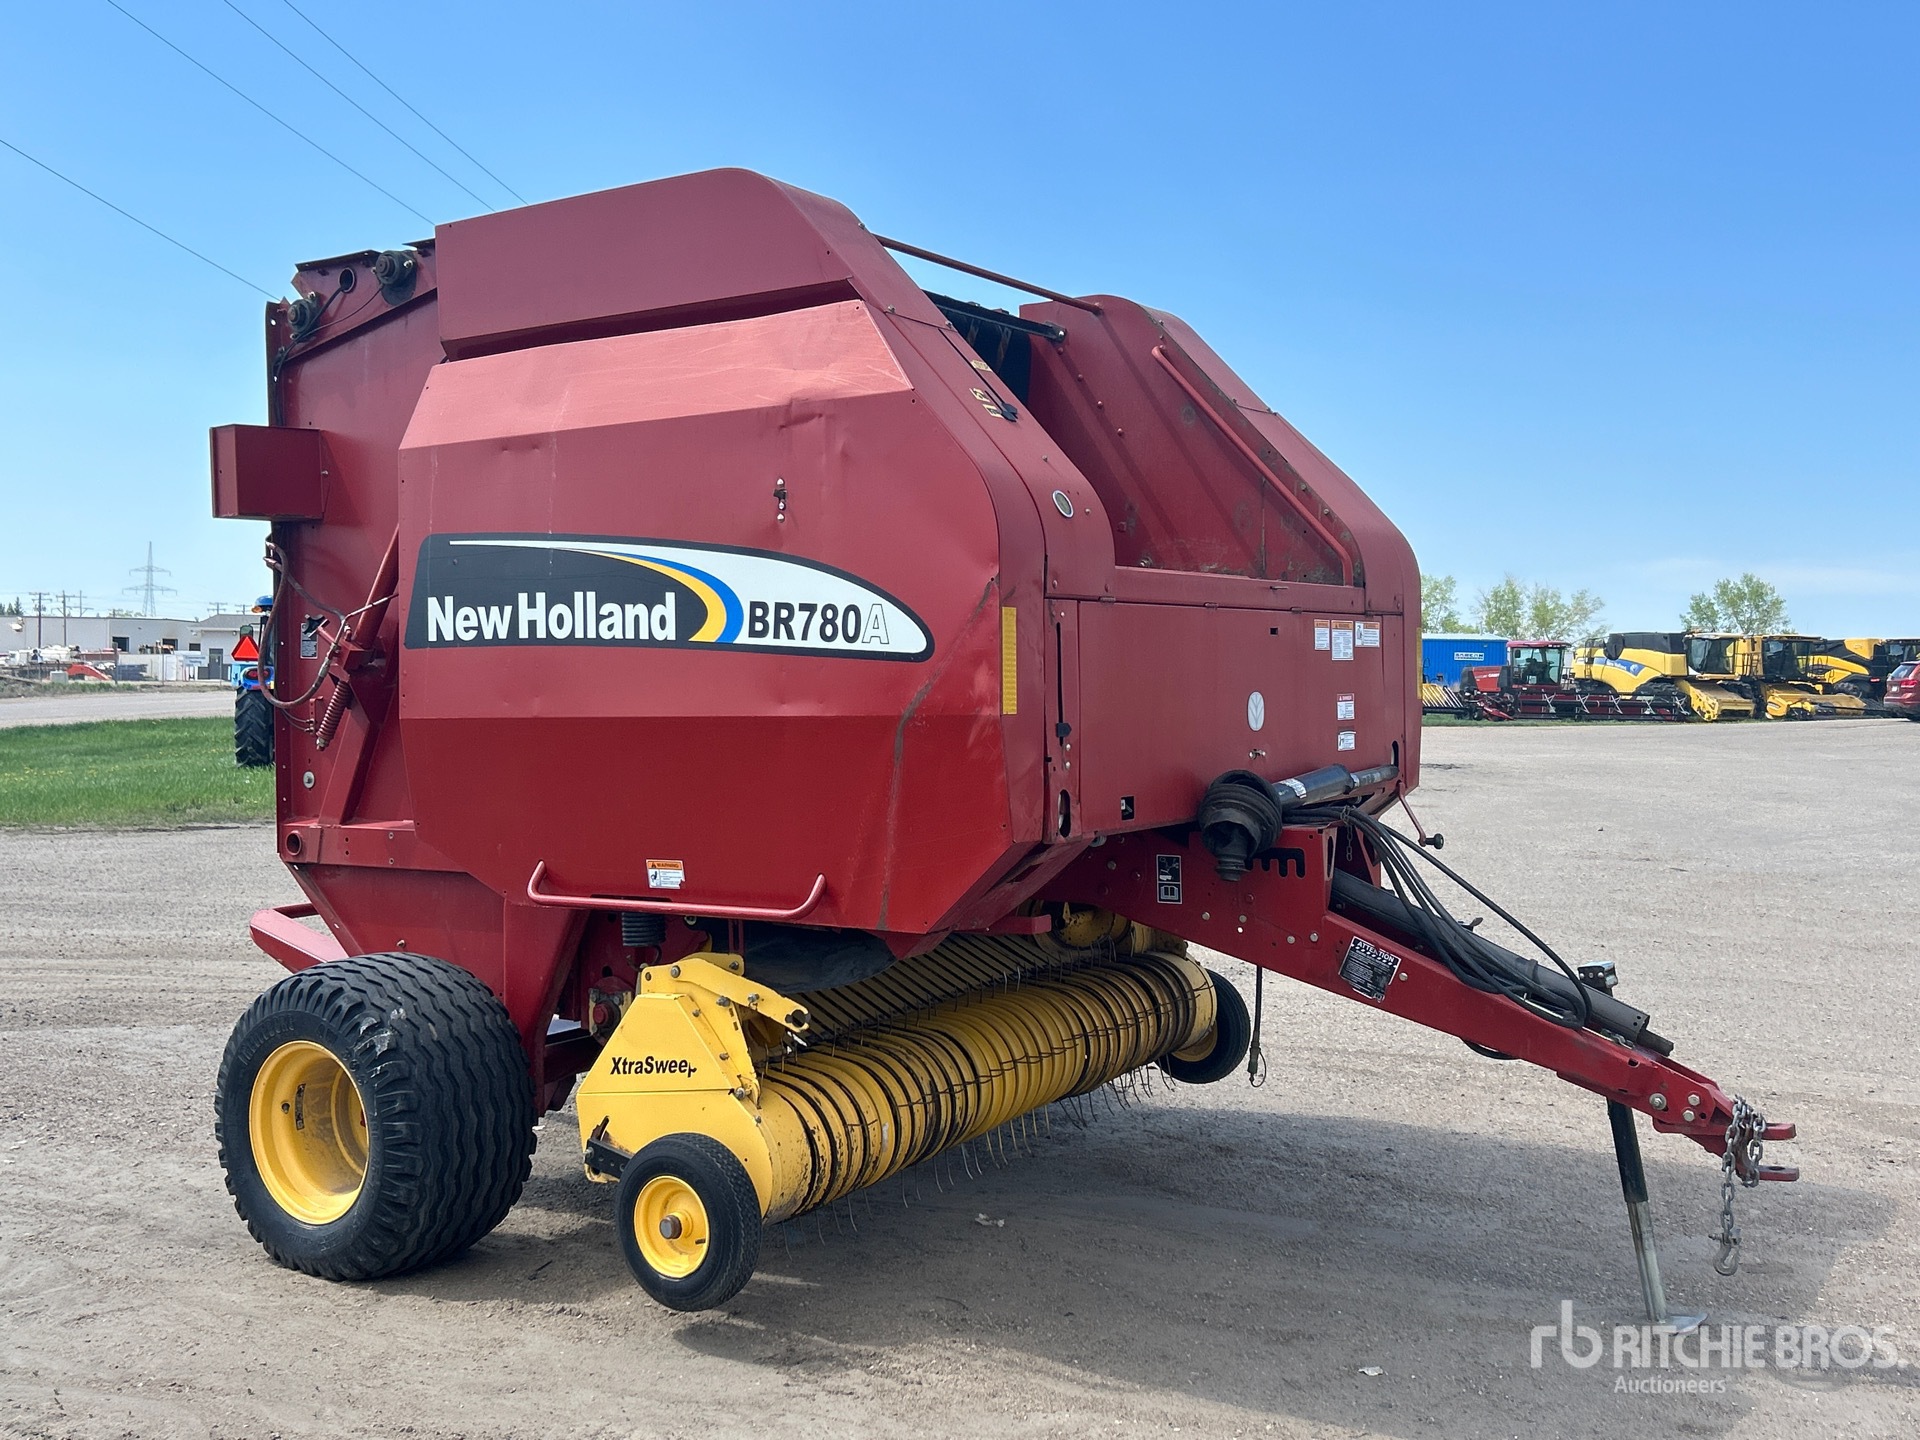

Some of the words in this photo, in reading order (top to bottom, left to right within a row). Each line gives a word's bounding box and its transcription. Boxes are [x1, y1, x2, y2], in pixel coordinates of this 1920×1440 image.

[427, 595, 513, 641] New
[518, 591, 676, 641] Holland
[748, 600, 890, 644] BR780A
